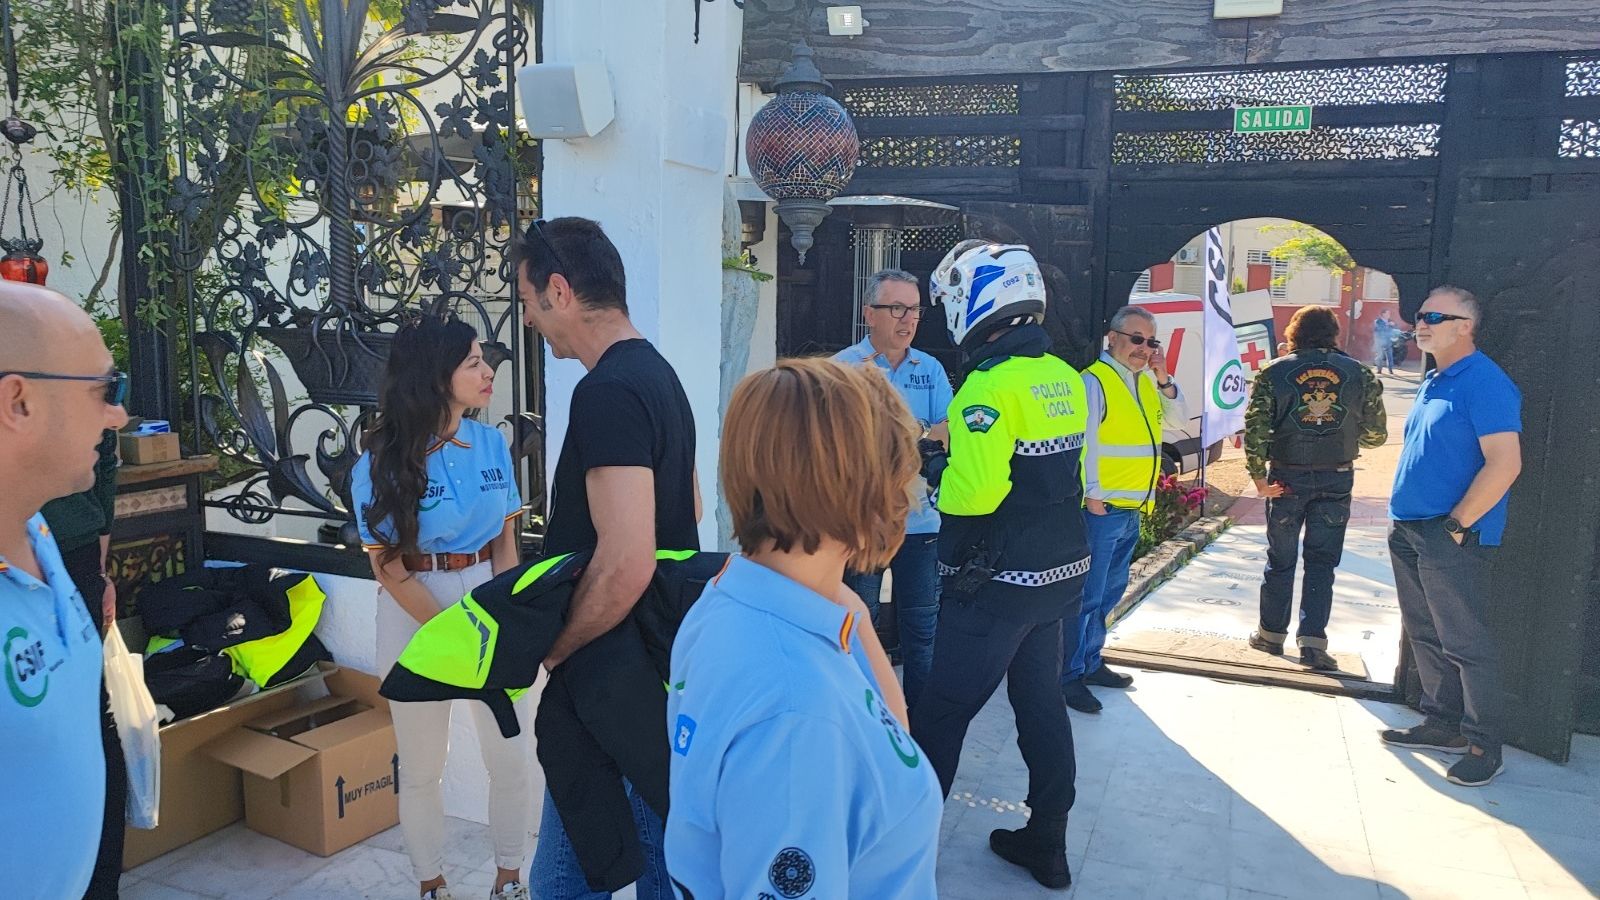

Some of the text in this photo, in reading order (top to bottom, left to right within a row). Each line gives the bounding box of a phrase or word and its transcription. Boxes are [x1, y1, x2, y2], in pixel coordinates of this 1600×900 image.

[1241, 110, 1305, 128] SALIDA
[1030, 381, 1072, 400] POLICIA
[344, 775, 394, 804] MUY FRAGIL
